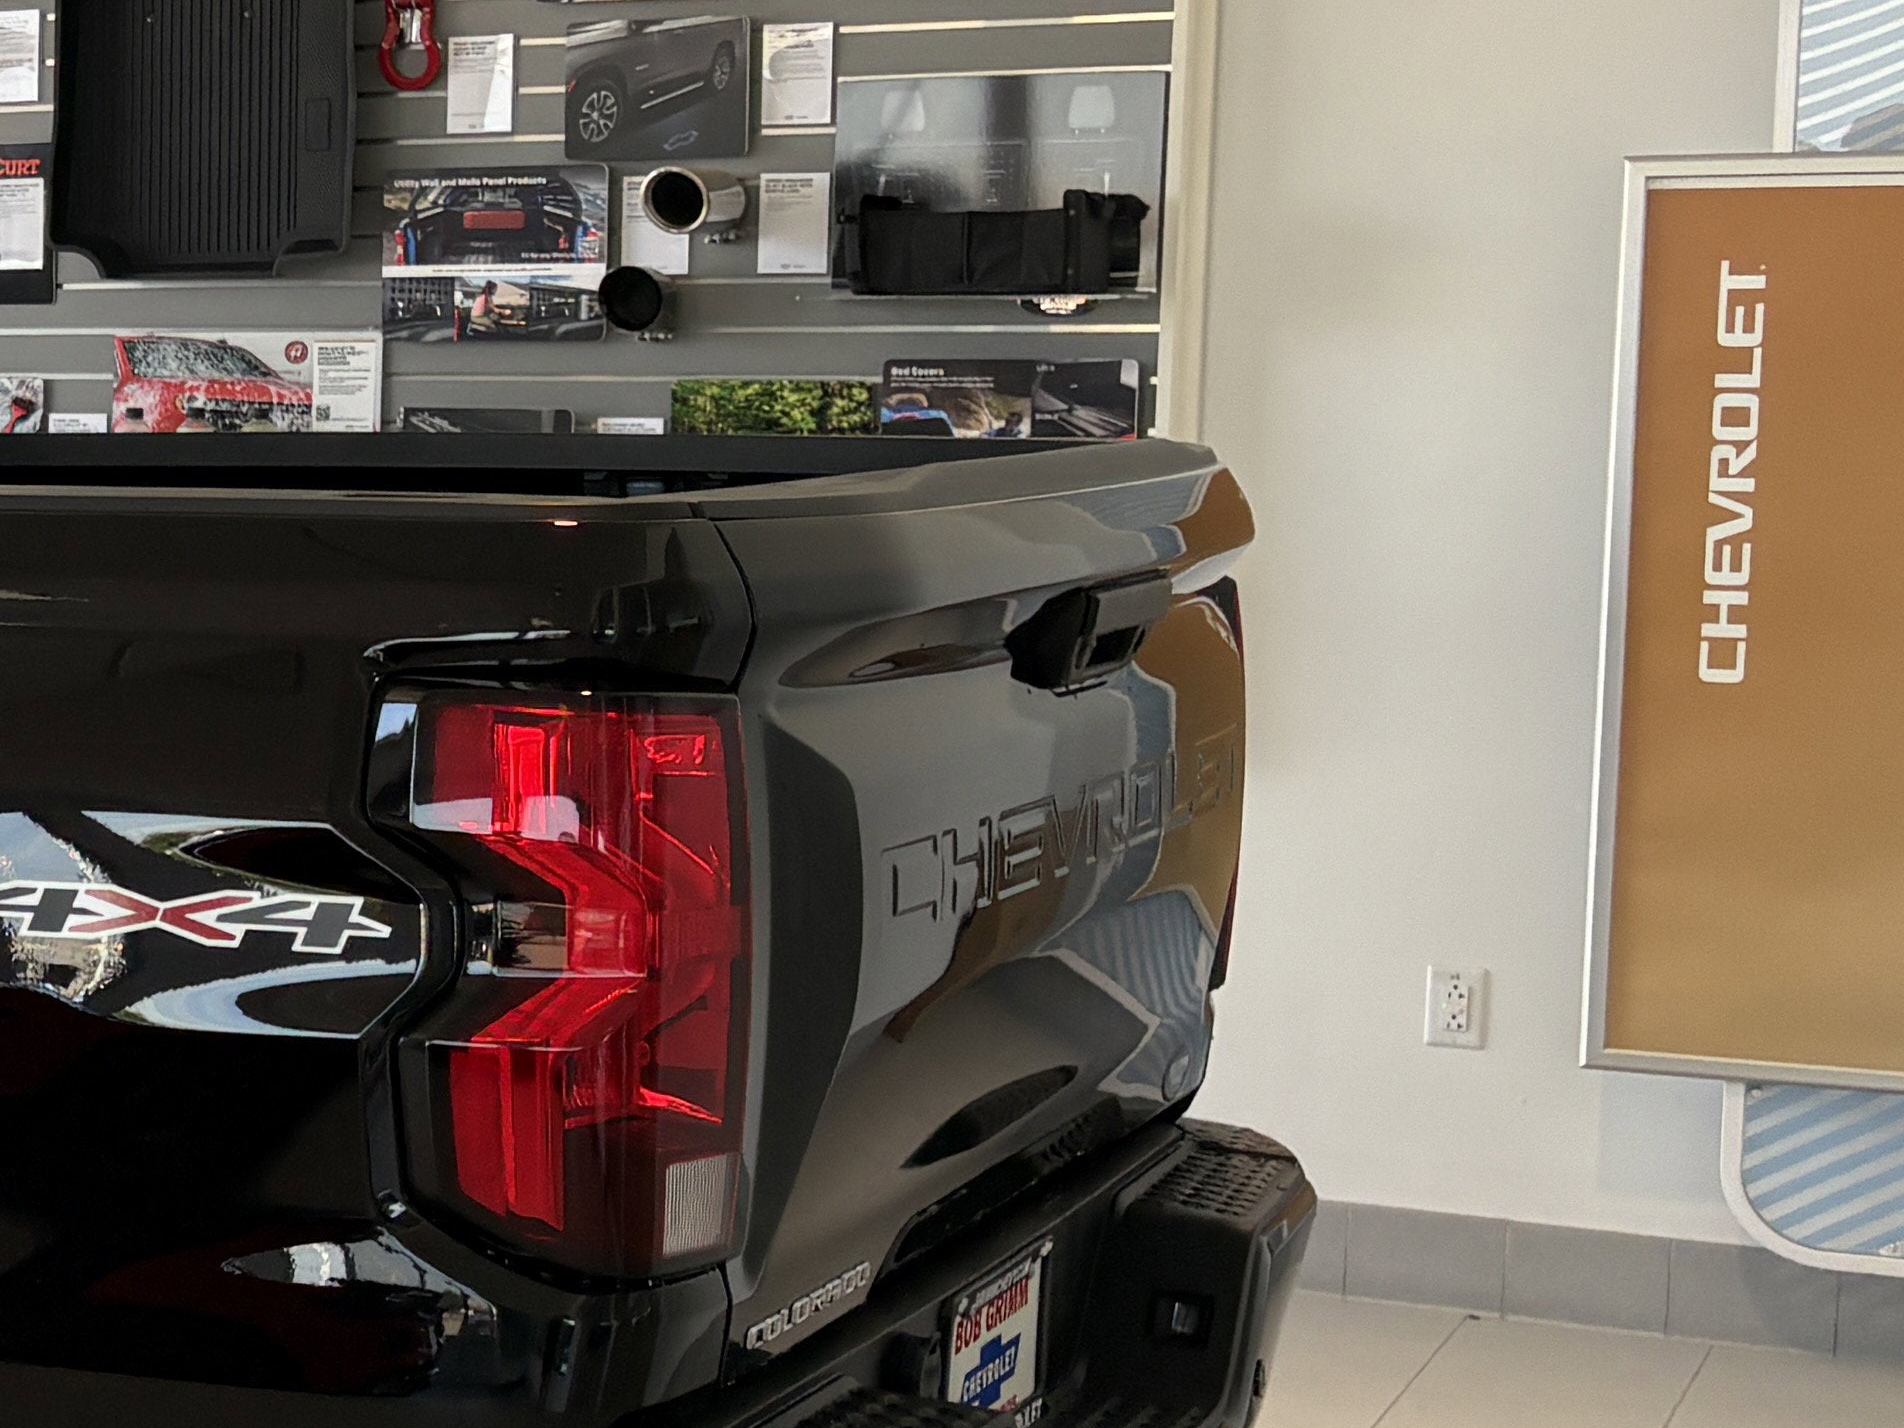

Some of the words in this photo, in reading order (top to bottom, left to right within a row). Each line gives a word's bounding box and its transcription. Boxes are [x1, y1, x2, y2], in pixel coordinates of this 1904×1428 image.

[1698, 260, 1767, 684] CHEVROLET
[880, 722, 1237, 924] CHEVROLET
[746, 1261, 872, 1351] COLORADO
[954, 1306, 983, 1356] BOB
[985, 1274, 1030, 1333] GRIMM
[962, 1345, 1017, 1403] CHEVROLET
